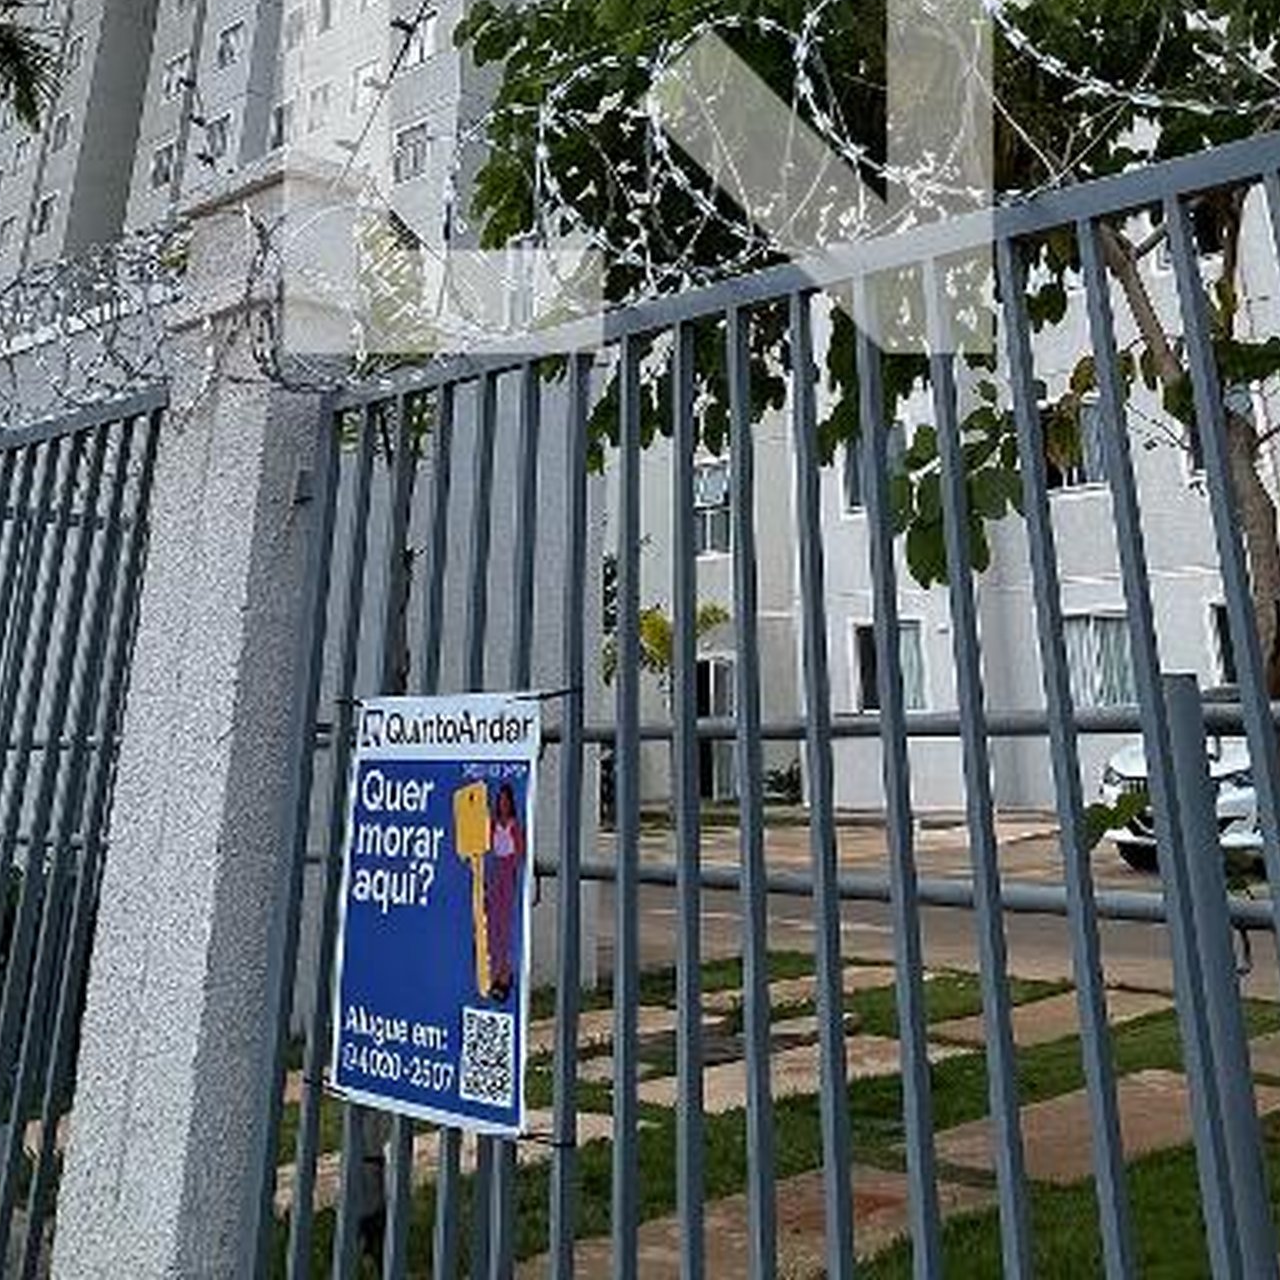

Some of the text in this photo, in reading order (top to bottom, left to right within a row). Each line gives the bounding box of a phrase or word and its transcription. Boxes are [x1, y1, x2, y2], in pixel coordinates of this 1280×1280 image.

[385, 711, 533, 745] QuintoAndar
[362, 770, 434, 812] Quer
[357, 823, 445, 860] morar
[352, 862, 434, 915] aqui?
[345, 1005, 448, 1051] Alugue em:
